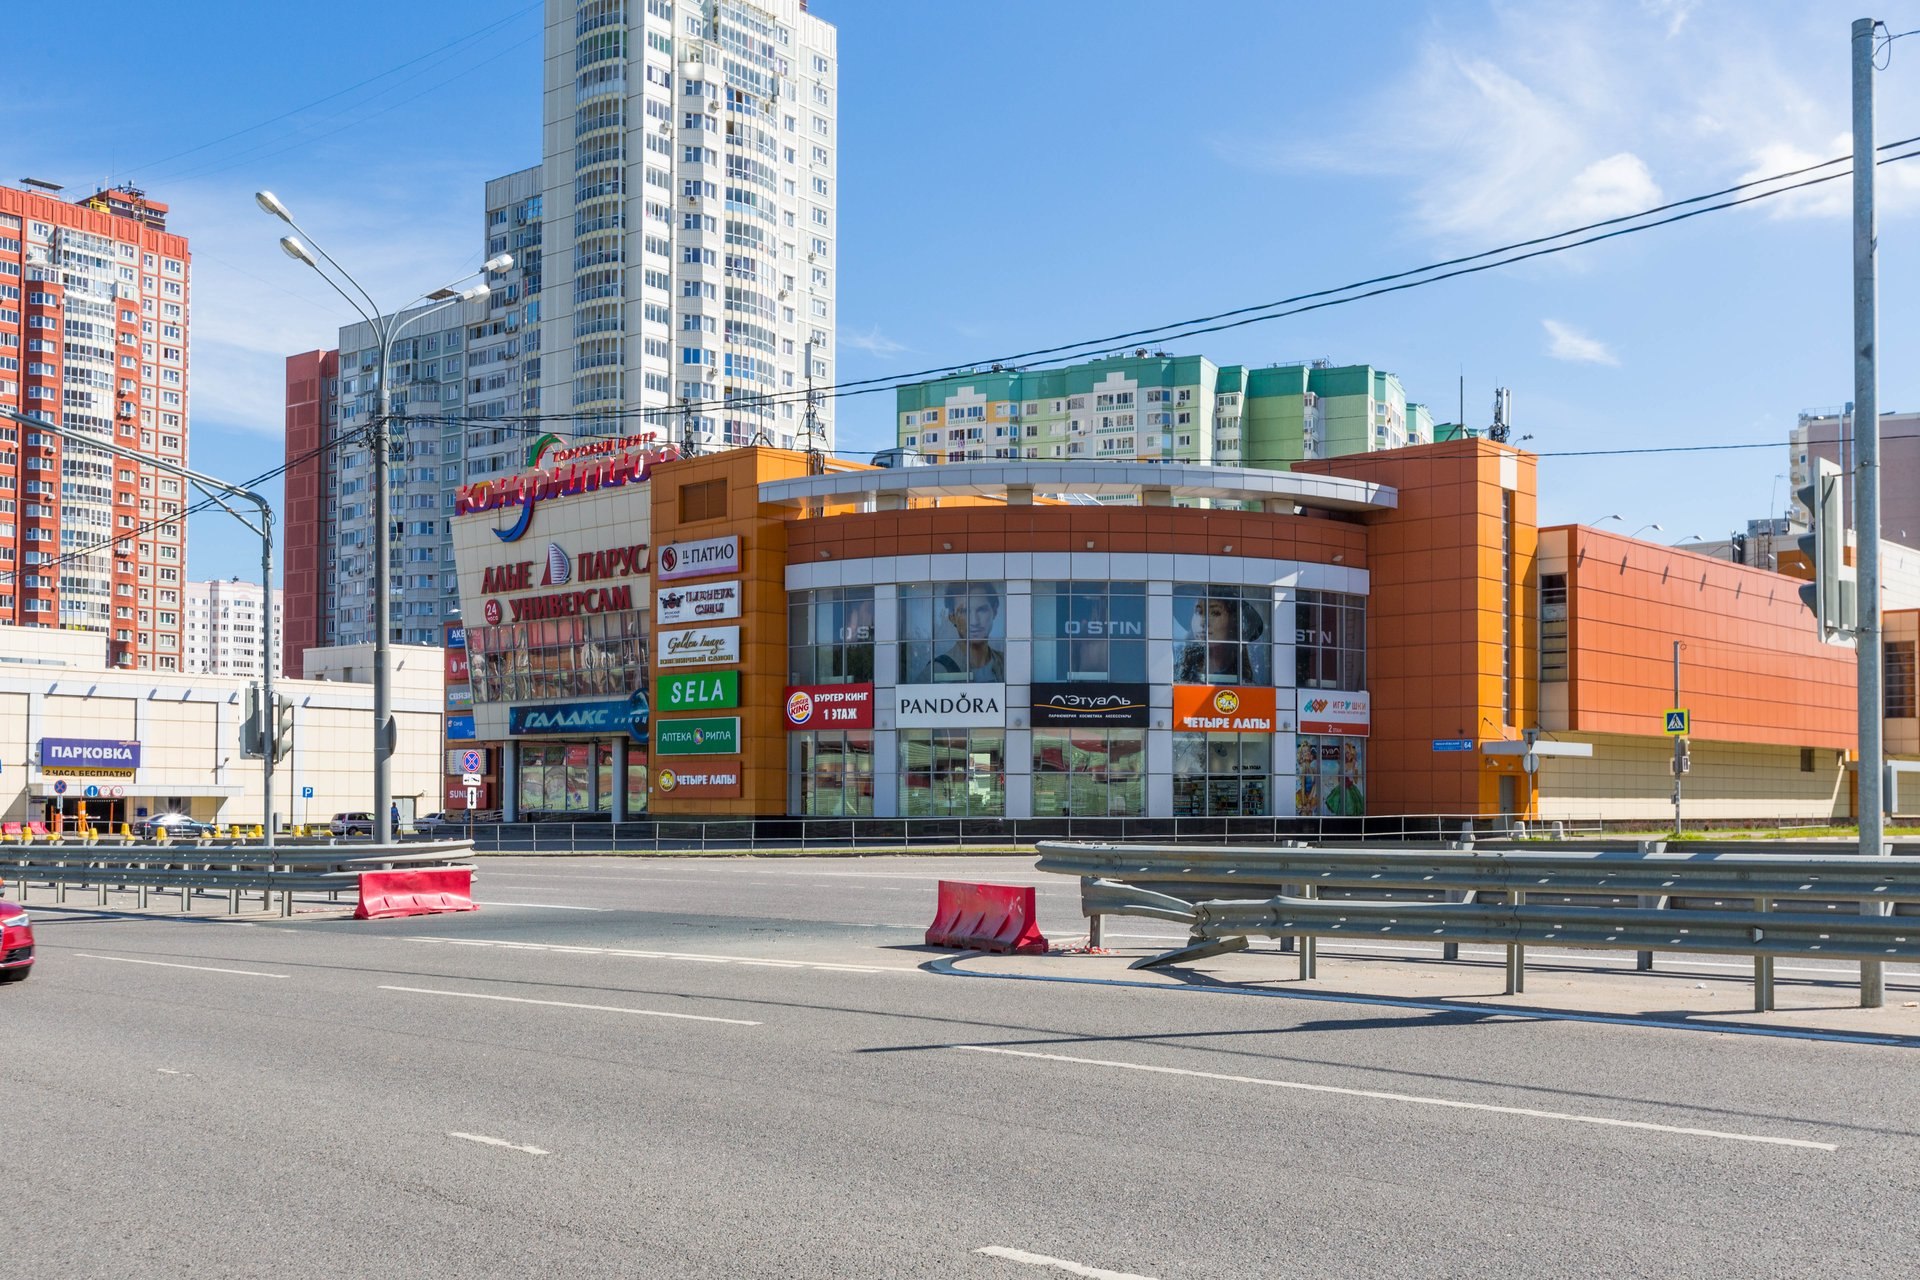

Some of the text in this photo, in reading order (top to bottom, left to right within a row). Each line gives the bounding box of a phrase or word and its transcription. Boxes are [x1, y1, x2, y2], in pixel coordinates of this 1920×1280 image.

[691, 543, 734, 563] ПАТИО
[481, 560, 534, 595] АЛЫЕ
[486, 603, 497, 616] 24
[508, 584, 632, 623] УНИВЕРСАМ
[667, 630, 726, 655] Golden Image
[671, 679, 724, 704] SELA
[814, 692, 868, 703] БУРГЕР КИНГ
[790, 703, 809, 716] KING
[900, 697, 999, 714] PANDORA
[823, 708, 858, 720] 1 ЭТАЖ
[1183, 716, 1271, 730] ЧЕТЫРЕ ЛАПЫ
[661, 730, 732, 742] АПТЕКА РИГЛА
[51, 745, 133, 760] ПАРКОВКА
[52, 769, 76, 777] ЧАСА
[78, 770, 132, 778] БЕСПЛАТНО
[677, 775, 708, 786] ЧЕТЫРЕ
[709, 774, 737, 785] ЛАПЫ
[449, 790, 484, 799] SUNLHT
